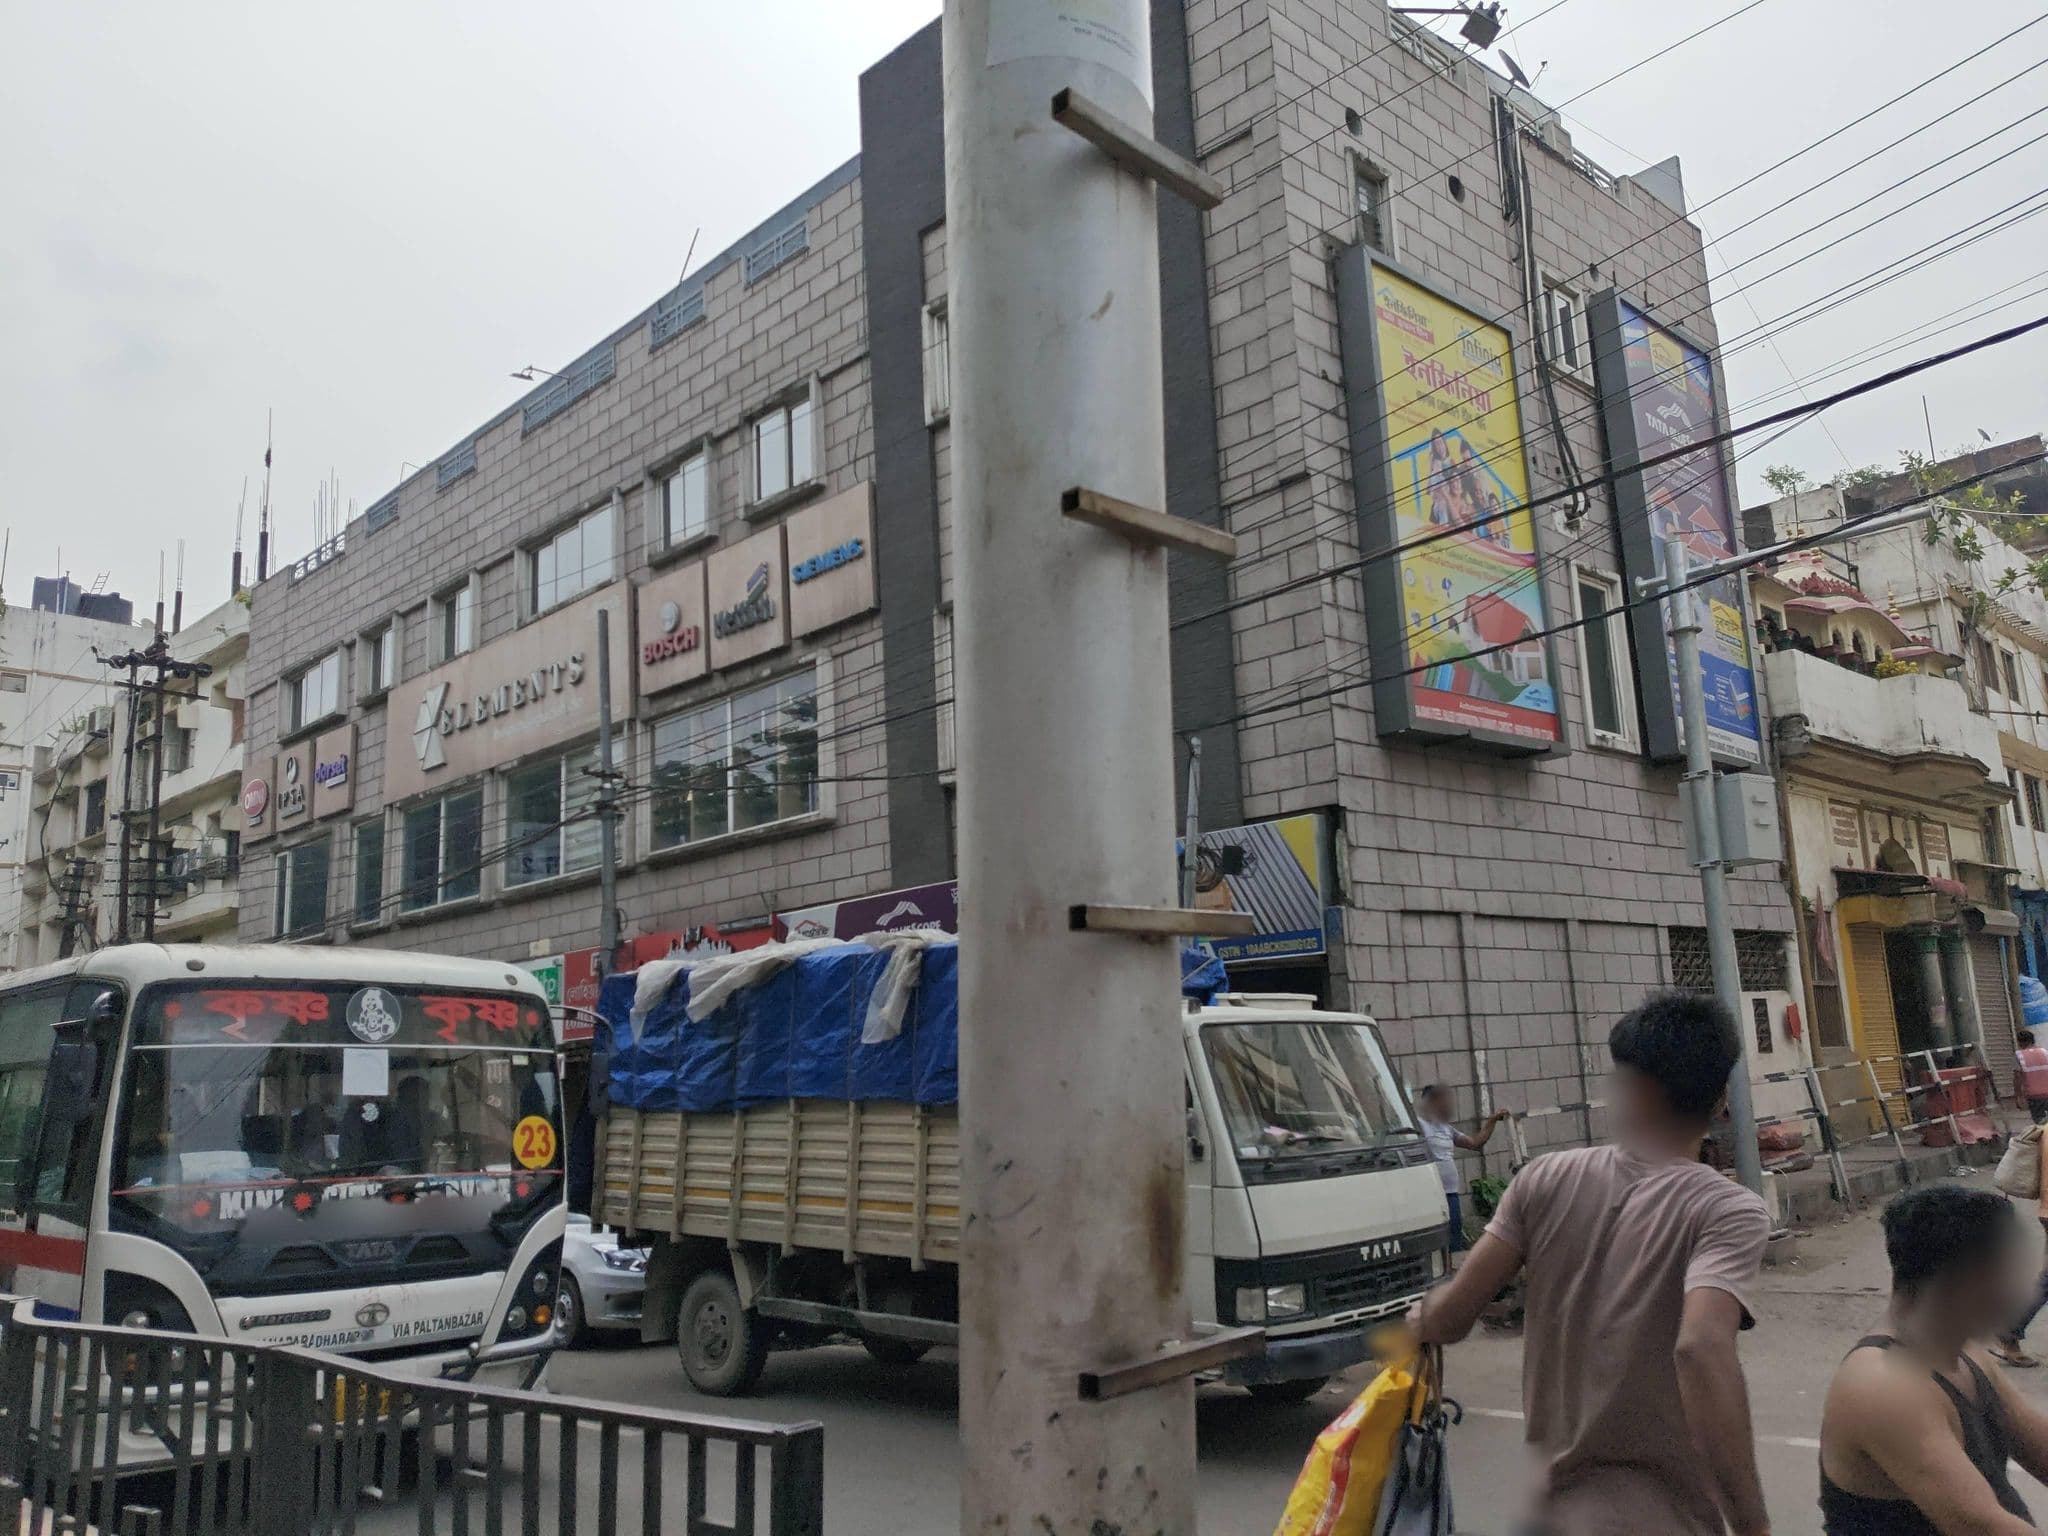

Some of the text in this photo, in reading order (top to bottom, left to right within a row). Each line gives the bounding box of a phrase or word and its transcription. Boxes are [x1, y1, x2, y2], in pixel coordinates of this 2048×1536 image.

[1645, 412, 1669, 436] TATA
[791, 537, 865, 585] SIEMENS
[643, 624, 700, 666] BOSCH
[440, 653, 586, 737] ELEMENTS
[198, 989, 330, 1041] কৃষ্ণ
[419, 993, 520, 1045] কৃষ্ণ
[519, 1123, 552, 1160] 23
[344, 1241, 398, 1258] TATA
[1359, 1239, 1402, 1262] TATA
[392, 1311, 485, 1338] VIA PALTANBAZAR
